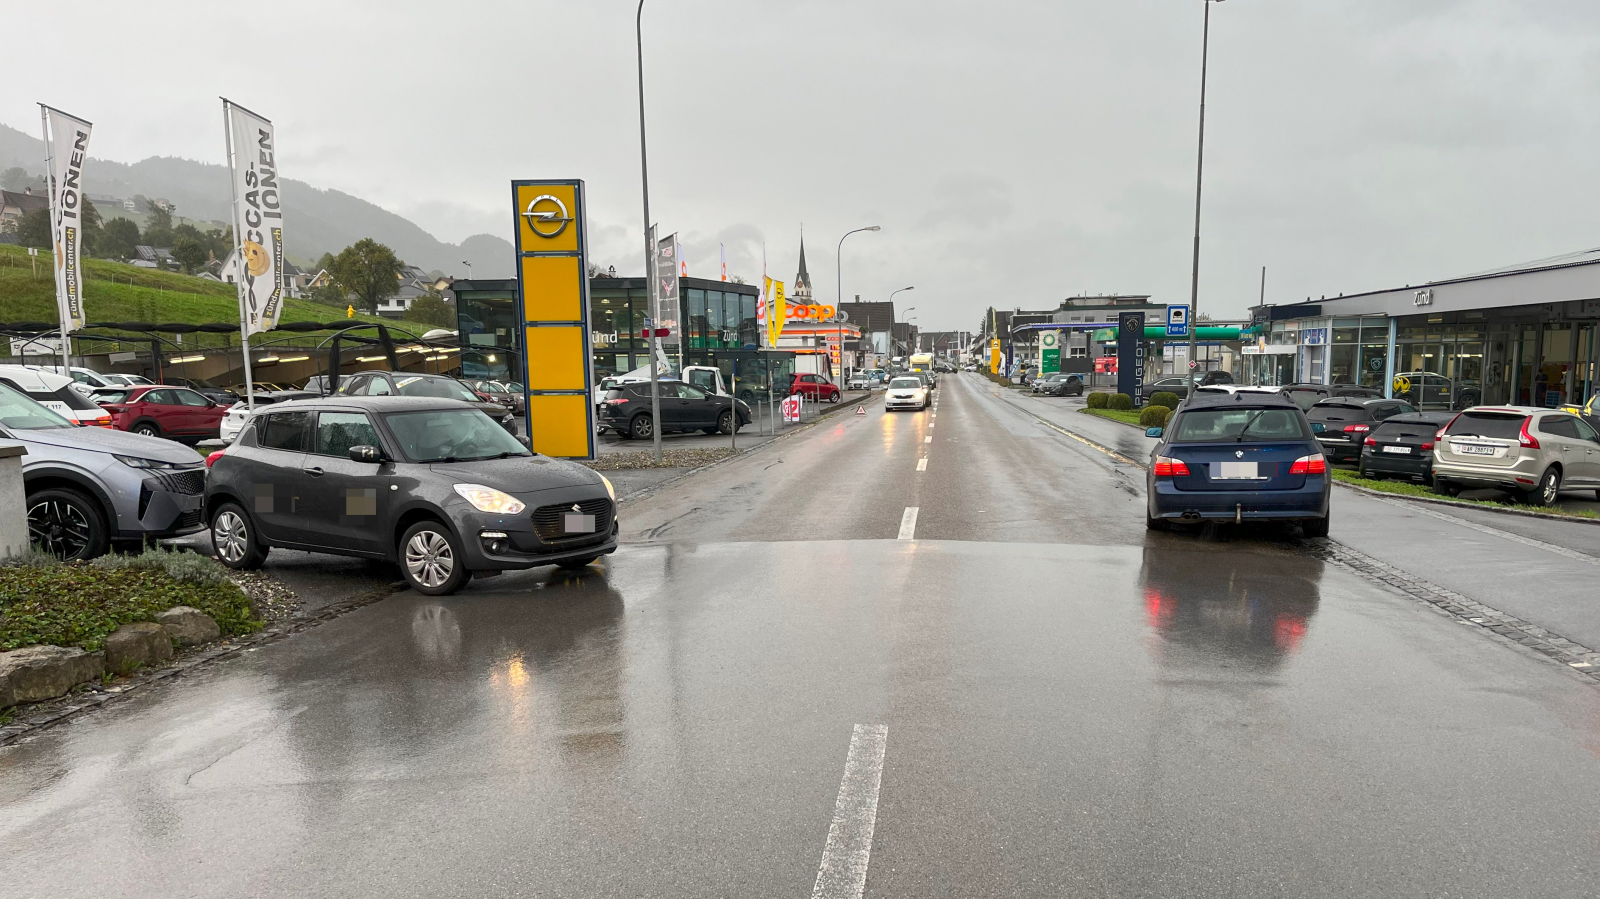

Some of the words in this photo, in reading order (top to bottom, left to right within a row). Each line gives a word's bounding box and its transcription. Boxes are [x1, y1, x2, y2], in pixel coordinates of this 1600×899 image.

[63, 129, 87, 219] IONEN
[258, 128, 282, 219] IONEN
[592, 330, 618, 345] ünd
[785, 304, 836, 322] coop
[1134, 338, 1144, 406] PEUGEOT
